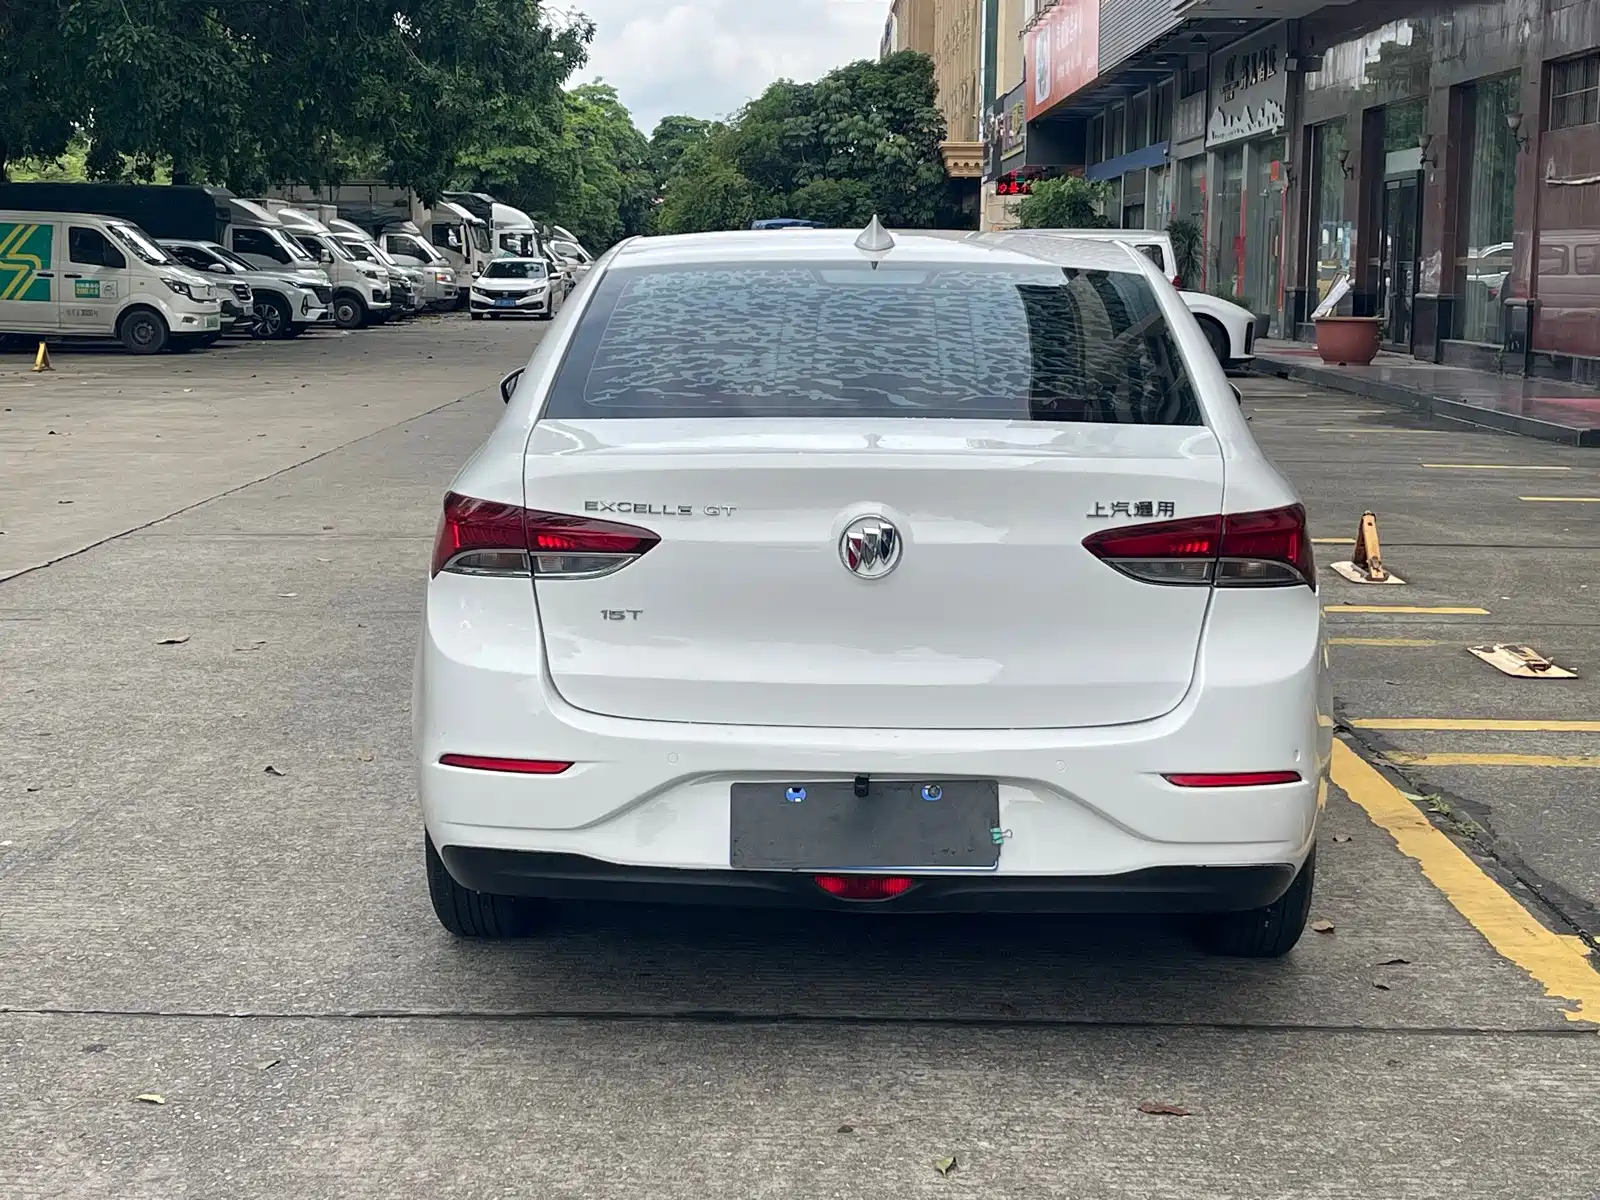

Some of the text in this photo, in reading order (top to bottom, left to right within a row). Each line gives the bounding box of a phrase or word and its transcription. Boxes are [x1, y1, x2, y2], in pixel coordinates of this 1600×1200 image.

[584, 500, 737, 517] EXCELLE GT
[1086, 500, 1175, 518] 上汽通用
[600, 609, 643, 621] 15T
